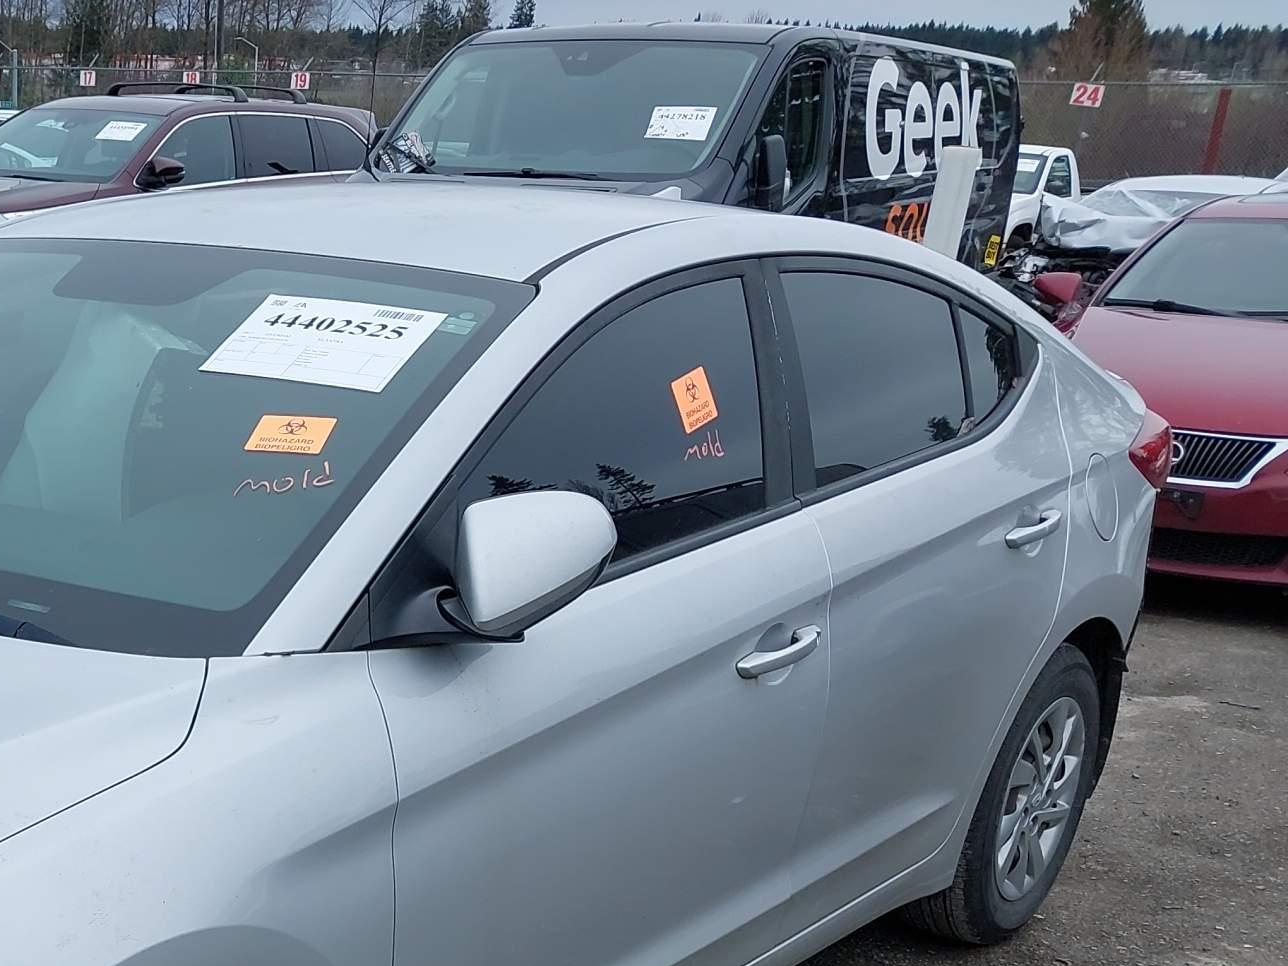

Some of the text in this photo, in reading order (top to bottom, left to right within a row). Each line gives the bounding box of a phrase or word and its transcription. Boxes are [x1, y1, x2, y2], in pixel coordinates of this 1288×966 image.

[83, 71, 93, 85] 17
[185, 72, 197, 84] 18
[294, 73, 307, 88] 19
[1072, 84, 1101, 106] 24
[865, 56, 983, 180] Geek
[264, 312, 409, 340] 44402525
[259, 436, 315, 445] BIOHAZARD
[684, 428, 725, 461] mold
[233, 460, 335, 497] mold
